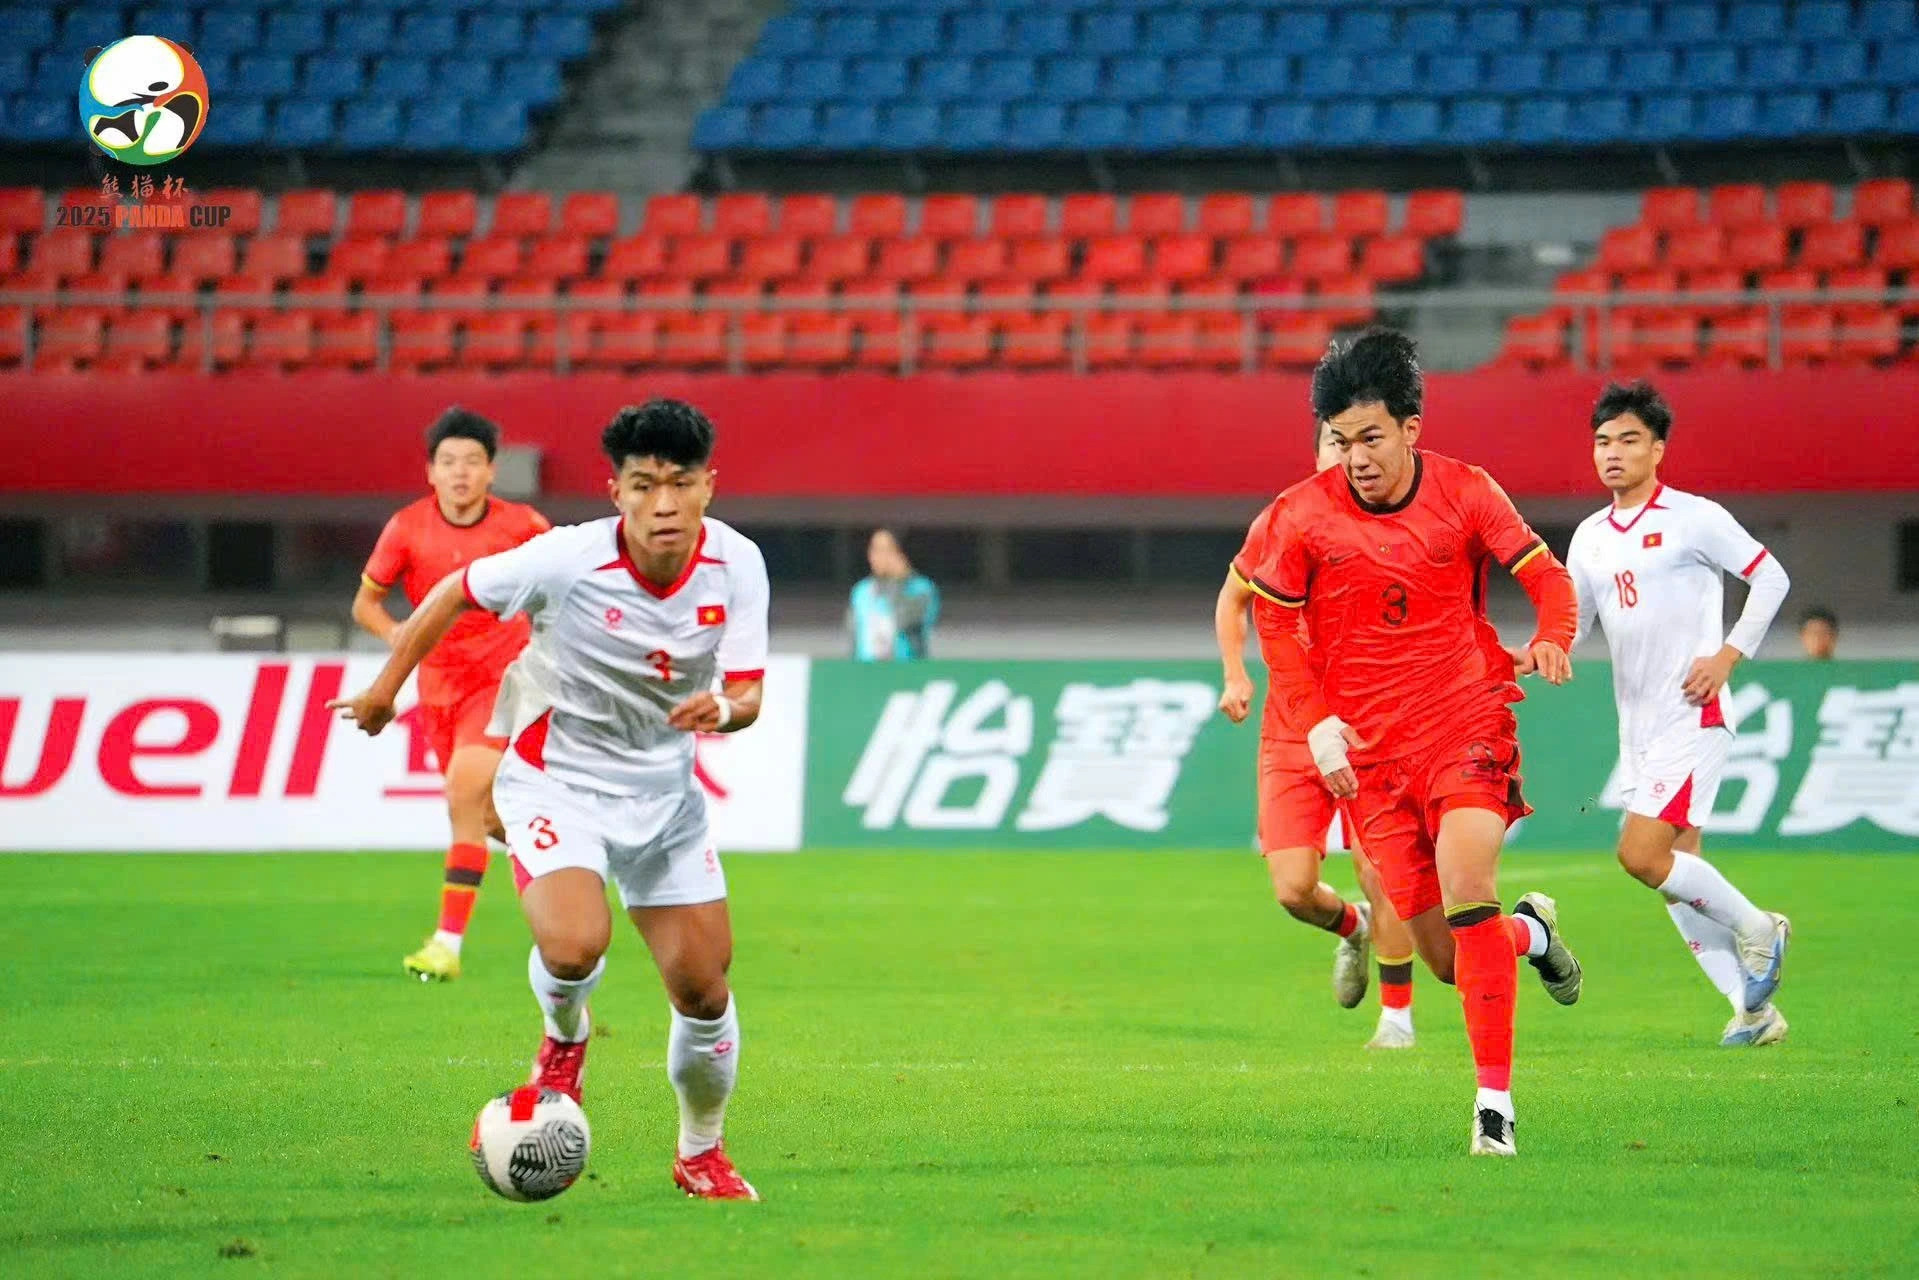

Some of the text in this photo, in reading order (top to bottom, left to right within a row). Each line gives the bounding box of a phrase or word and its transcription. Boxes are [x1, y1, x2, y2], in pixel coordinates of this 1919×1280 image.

[1382, 583, 1407, 625] 3
[1614, 570, 1638, 608] 18
[842, 679, 1217, 831] 怡寶
[528, 816, 559, 850] 3
